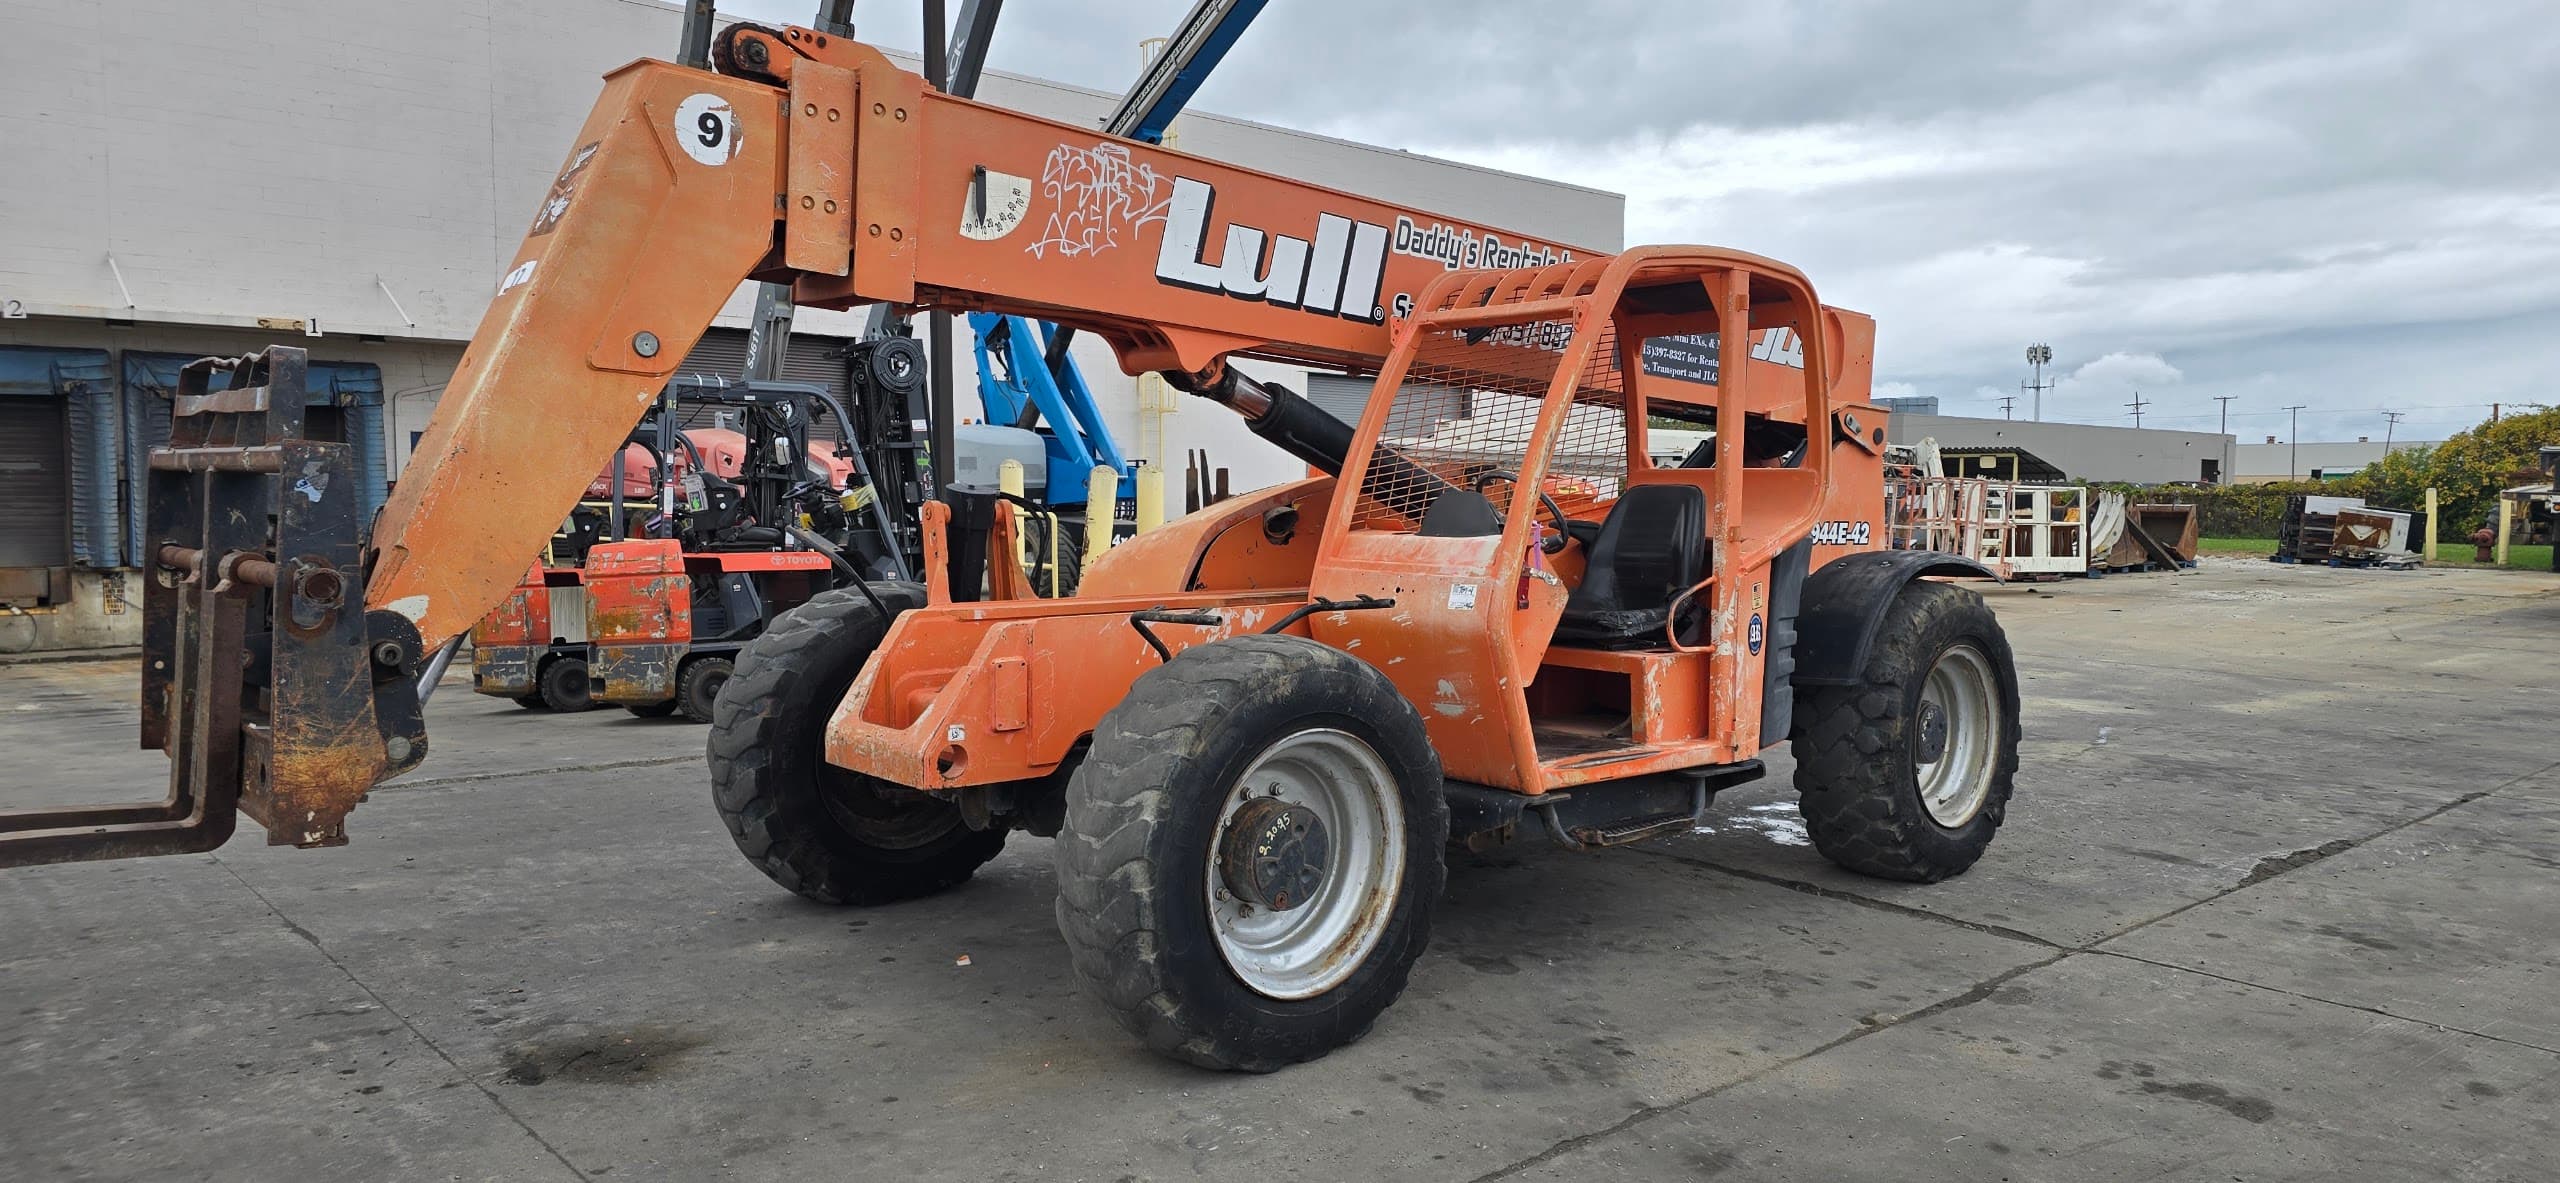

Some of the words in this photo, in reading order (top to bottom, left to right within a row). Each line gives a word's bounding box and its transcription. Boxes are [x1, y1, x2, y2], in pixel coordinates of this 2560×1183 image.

[697, 111, 724, 148] 9
[1393, 215, 1478, 270] Daddy's
[8, 299, 23, 317] 2
[309, 317, 319, 334] 1
[1688, 352, 1698, 364] for
[1652, 361, 1687, 378] Transport
[1689, 369, 1702, 379] and
[1811, 520, 1870, 546] 944E-42
[785, 555, 825, 566] TOYOTA
